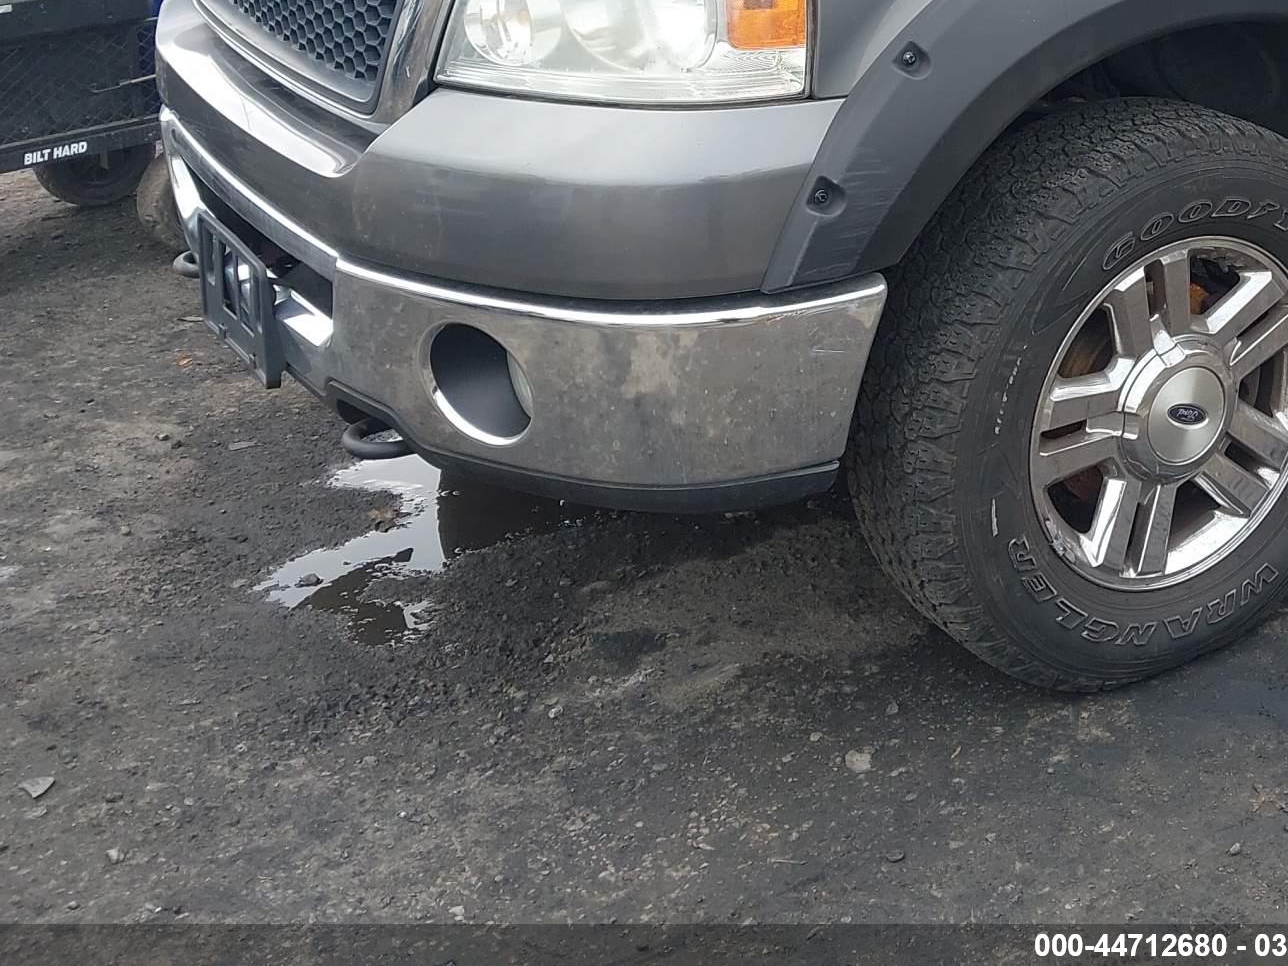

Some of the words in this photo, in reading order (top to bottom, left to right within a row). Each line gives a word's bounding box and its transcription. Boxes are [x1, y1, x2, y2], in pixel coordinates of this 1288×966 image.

[23, 148, 51, 165] BILT
[53, 141, 88, 159] HARD
[1007, 535, 1279, 646] WRANGLER
